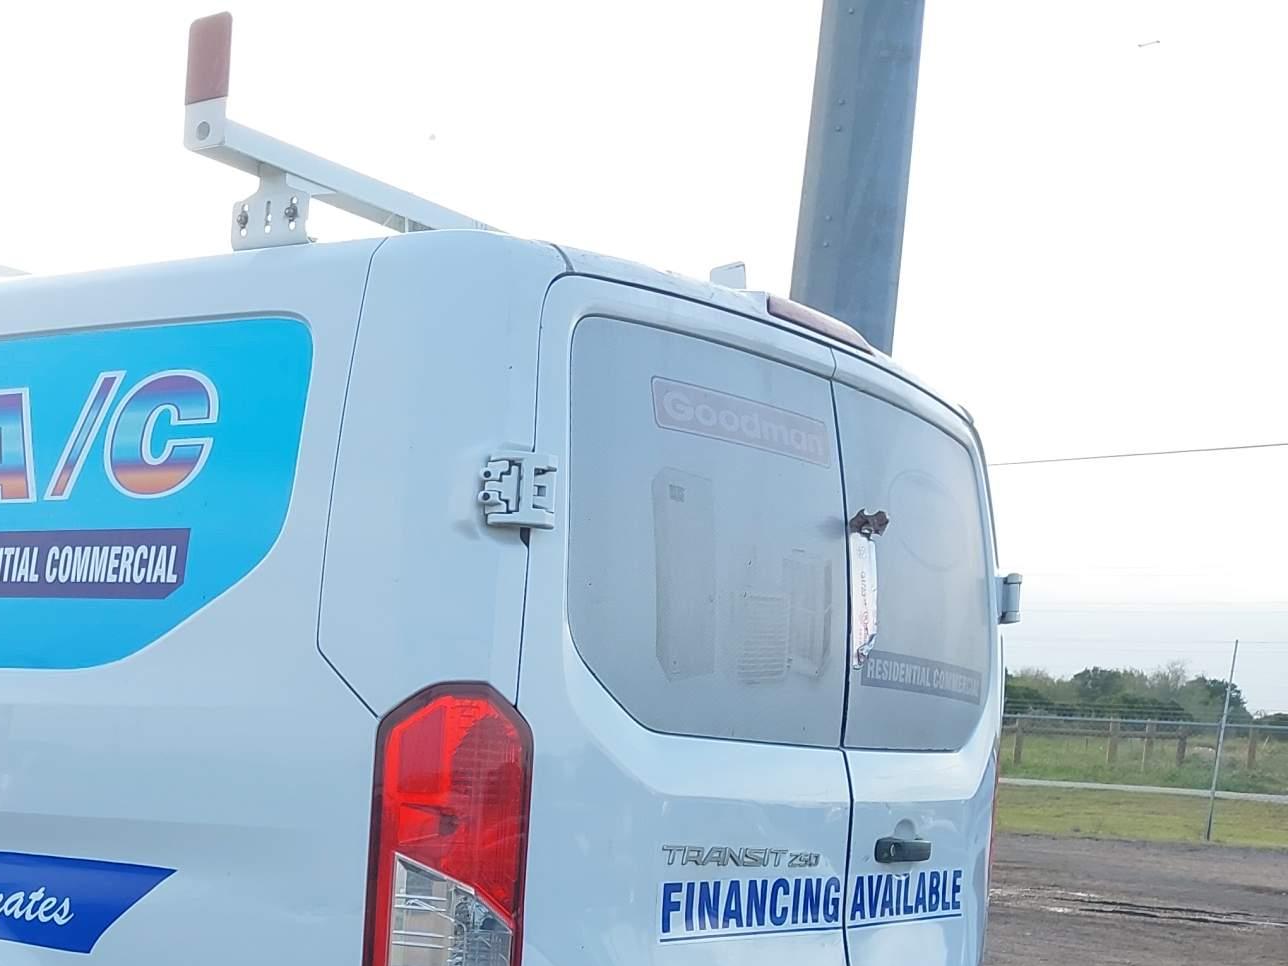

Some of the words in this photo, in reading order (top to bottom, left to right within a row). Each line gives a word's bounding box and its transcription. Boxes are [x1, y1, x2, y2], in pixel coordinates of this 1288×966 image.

[663, 390, 824, 457] Goodman
[44, 544, 178, 584] COMMERCIAL
[866, 658, 931, 687] RESIDENTIAL
[662, 845, 788, 867] TRANSIT
[660, 876, 841, 934] FINANCING
[849, 869, 963, 922] AVAILABLE
